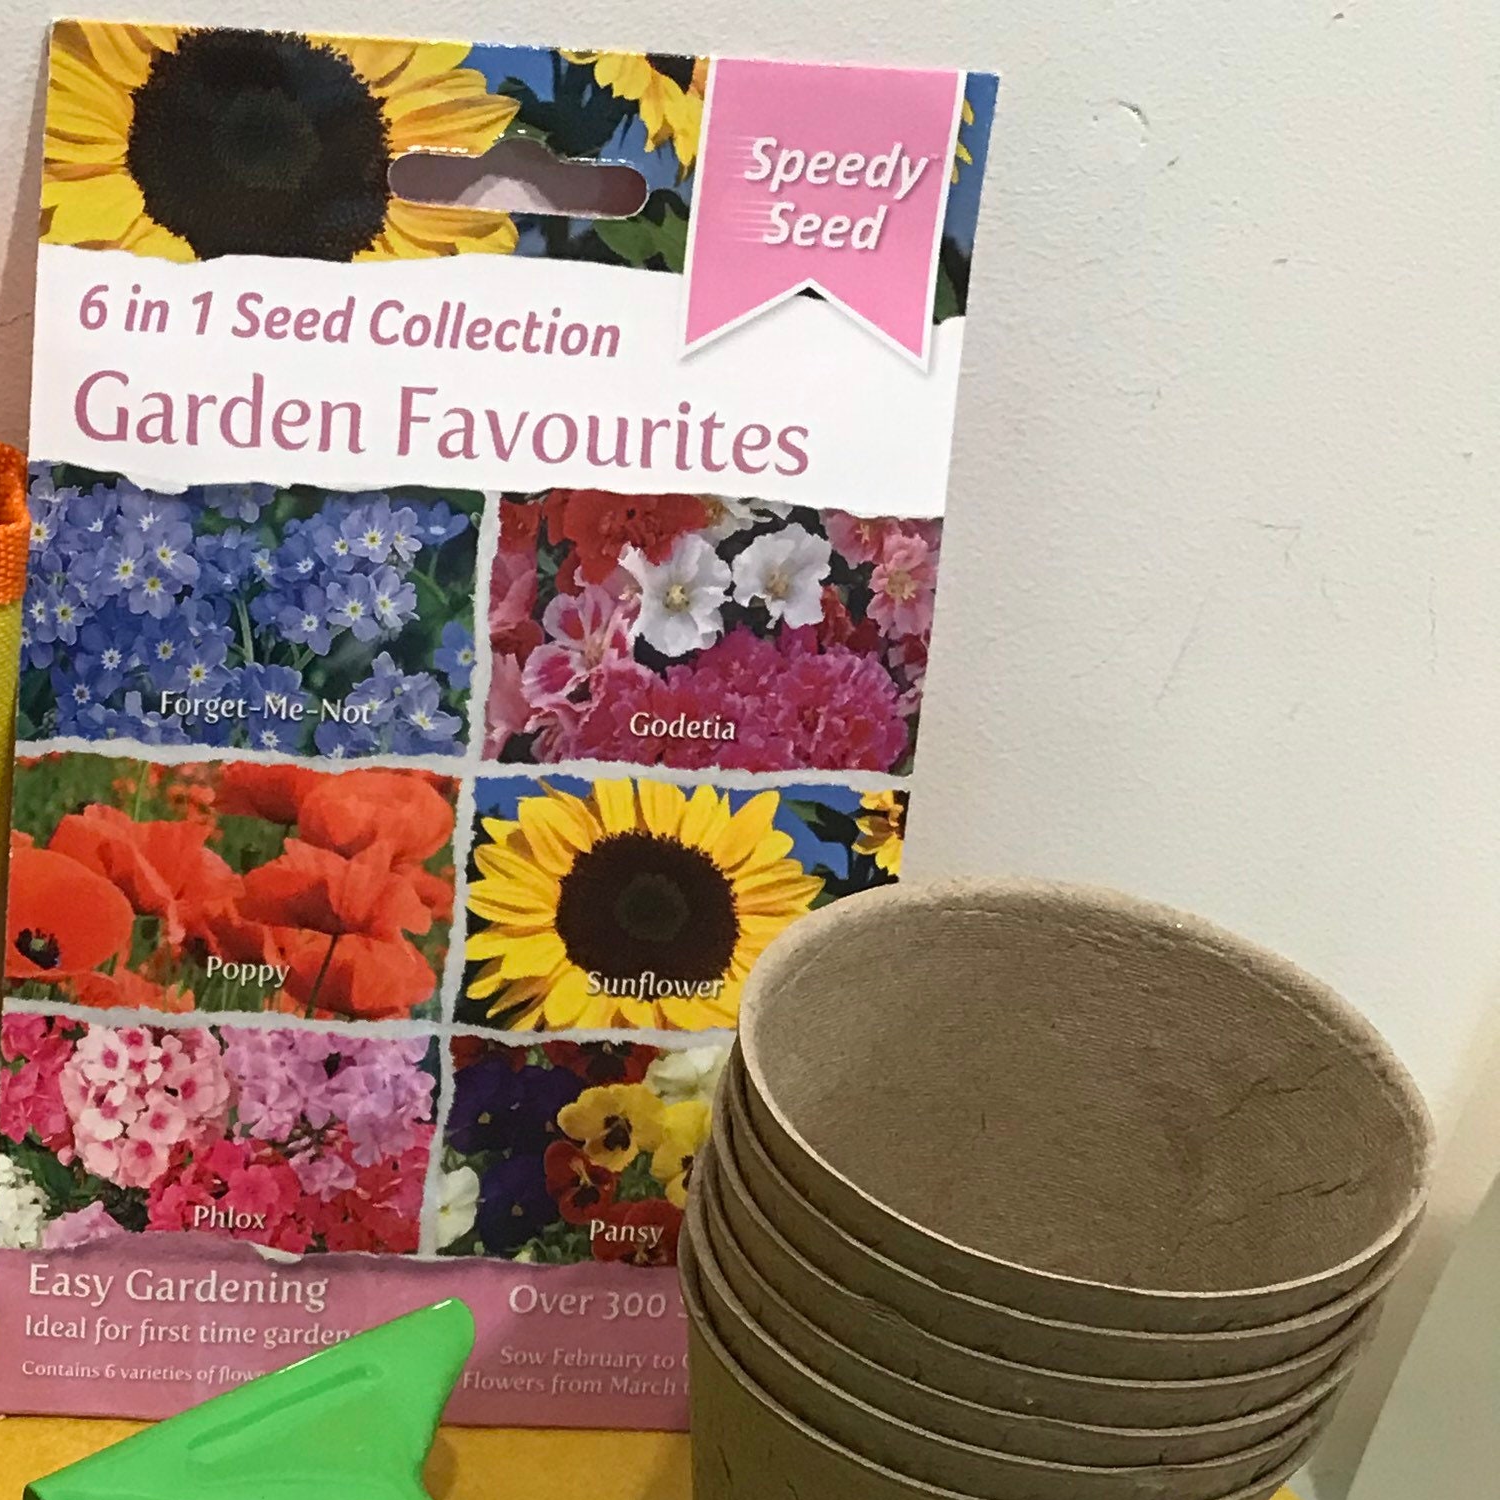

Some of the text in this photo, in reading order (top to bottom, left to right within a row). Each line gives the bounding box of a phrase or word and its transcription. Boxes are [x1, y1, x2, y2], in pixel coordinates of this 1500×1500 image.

[744, 136, 929, 200] Speedy
[763, 201, 888, 250] Seed
[79, 284, 621, 358] 6 in 1 Seed Collection
[74, 369, 810, 477] Garden Favourites
[159, 690, 373, 726] Forget-Me-Not
[629, 712, 737, 742] Godetia
[206, 956, 291, 989] Poppy
[586, 971, 725, 1003] Sunflower
[193, 1205, 266, 1231] Phlox
[589, 1219, 664, 1248] Pansy
[28, 1263, 329, 1313] Easy Gardening
[509, 1284, 594, 1316] Over
[602, 1291, 666, 1321] 300
[25, 1314, 364, 1350] Ideal for first time garden
[22, 1360, 100, 1379] Contains
[105, 1363, 116, 1379] 6
[120, 1363, 192, 1382] varieties
[197, 1364, 216, 1384] of
[500, 1346, 544, 1366] Sow
[553, 1348, 646, 1372] February
[653, 1352, 676, 1370] to
[462, 1370, 544, 1393] Flowers
[551, 1373, 602, 1395] from
[609, 1376, 676, 1397] March
